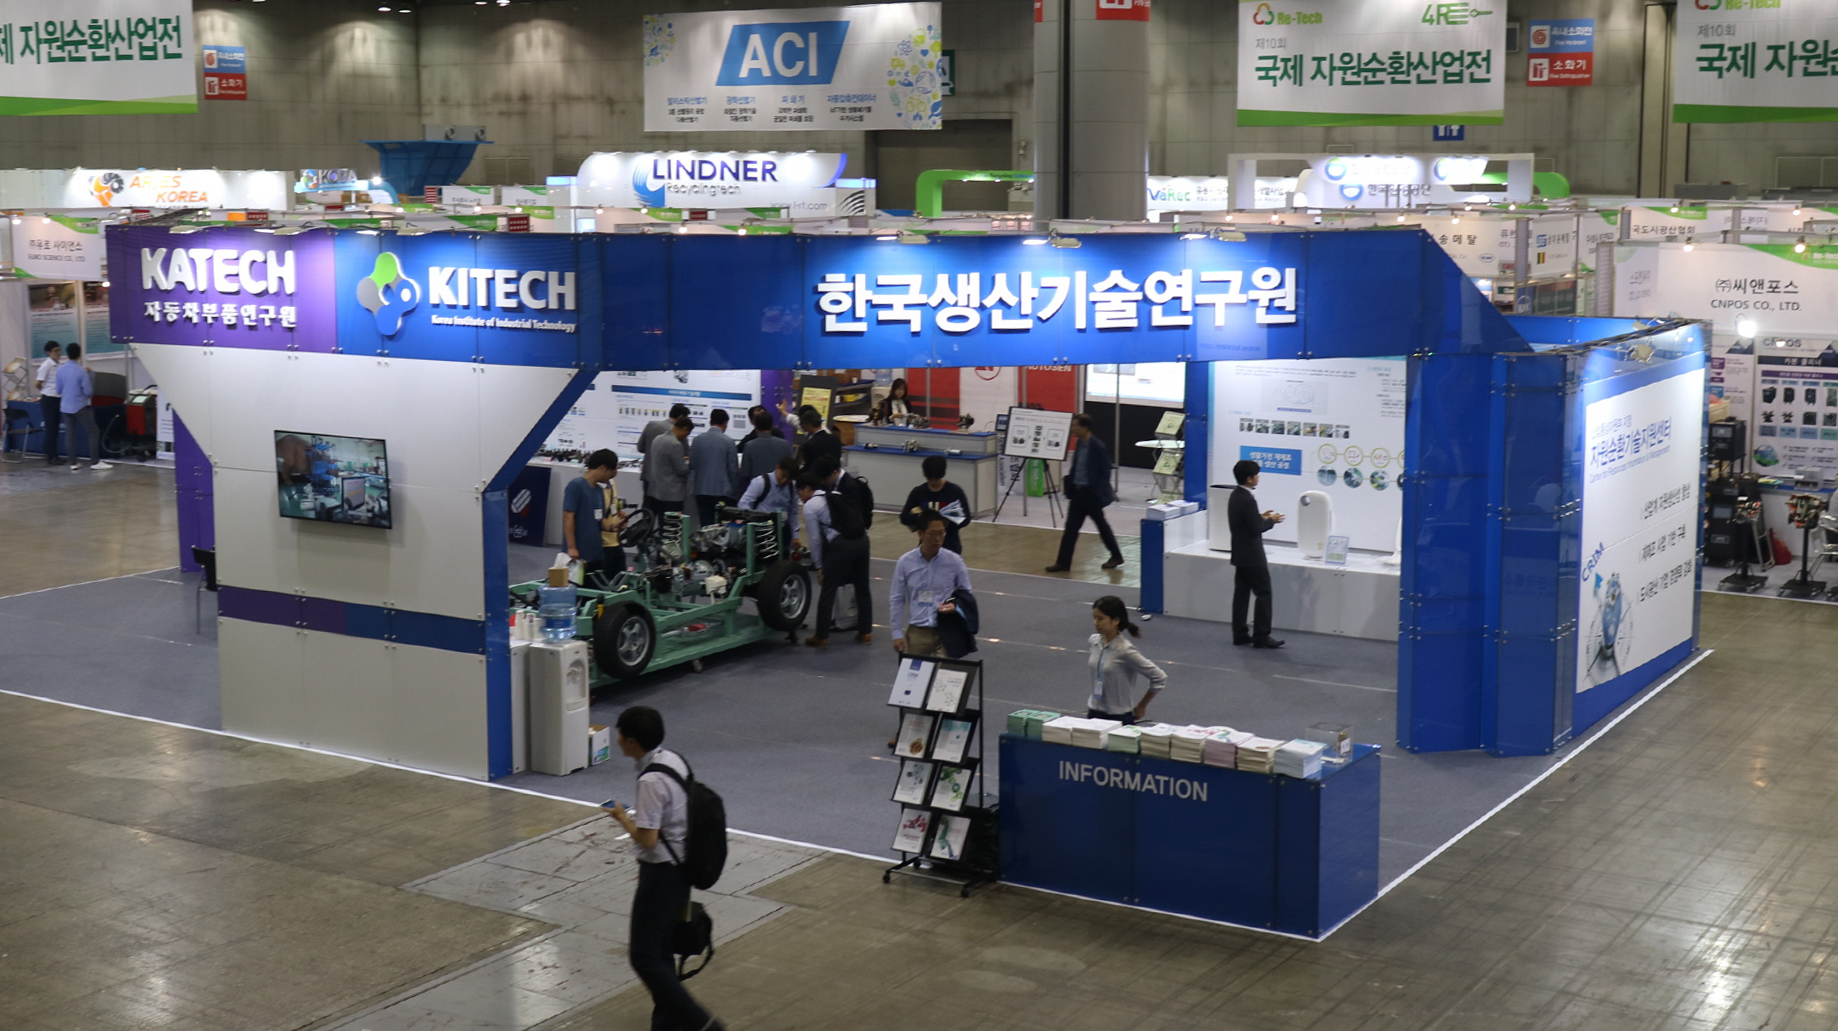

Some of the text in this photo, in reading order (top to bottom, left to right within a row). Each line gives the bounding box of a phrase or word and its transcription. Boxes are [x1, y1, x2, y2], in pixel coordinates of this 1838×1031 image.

[1277, 11, 1323, 25] Re-Tech
[1698, 24, 1736, 37] 제10회
[20, 15, 183, 64] 자원순환산업전
[1256, 38, 1287, 49] 제10회
[738, 32, 818, 78] ACI
[1255, 49, 1491, 87] 국제 자원순환산업전
[1553, 59, 1587, 70] 소화기
[1696, 42, 1757, 79] 국제
[652, 159, 778, 182] LINDNER
[156, 190, 208, 202] KOREA
[666, 182, 741, 197] Recyclingtech
[52, 240, 83, 251] 사이언스
[140, 247, 296, 295] KATECH
[429, 266, 576, 310] KITECH
[817, 267, 1298, 333] 한국생산기술연구원
[144, 300, 298, 328] 자동차부품연구원
[1710, 300, 1803, 312] CNPOS CO., LTD.
[431, 315, 577, 333] Korea Institute of Industrial Technology
[1589, 417, 1672, 468] 자원순환기술지원센터
[1583, 541, 1606, 582] CRIM
[1059, 760, 1208, 802] INFORMATION
